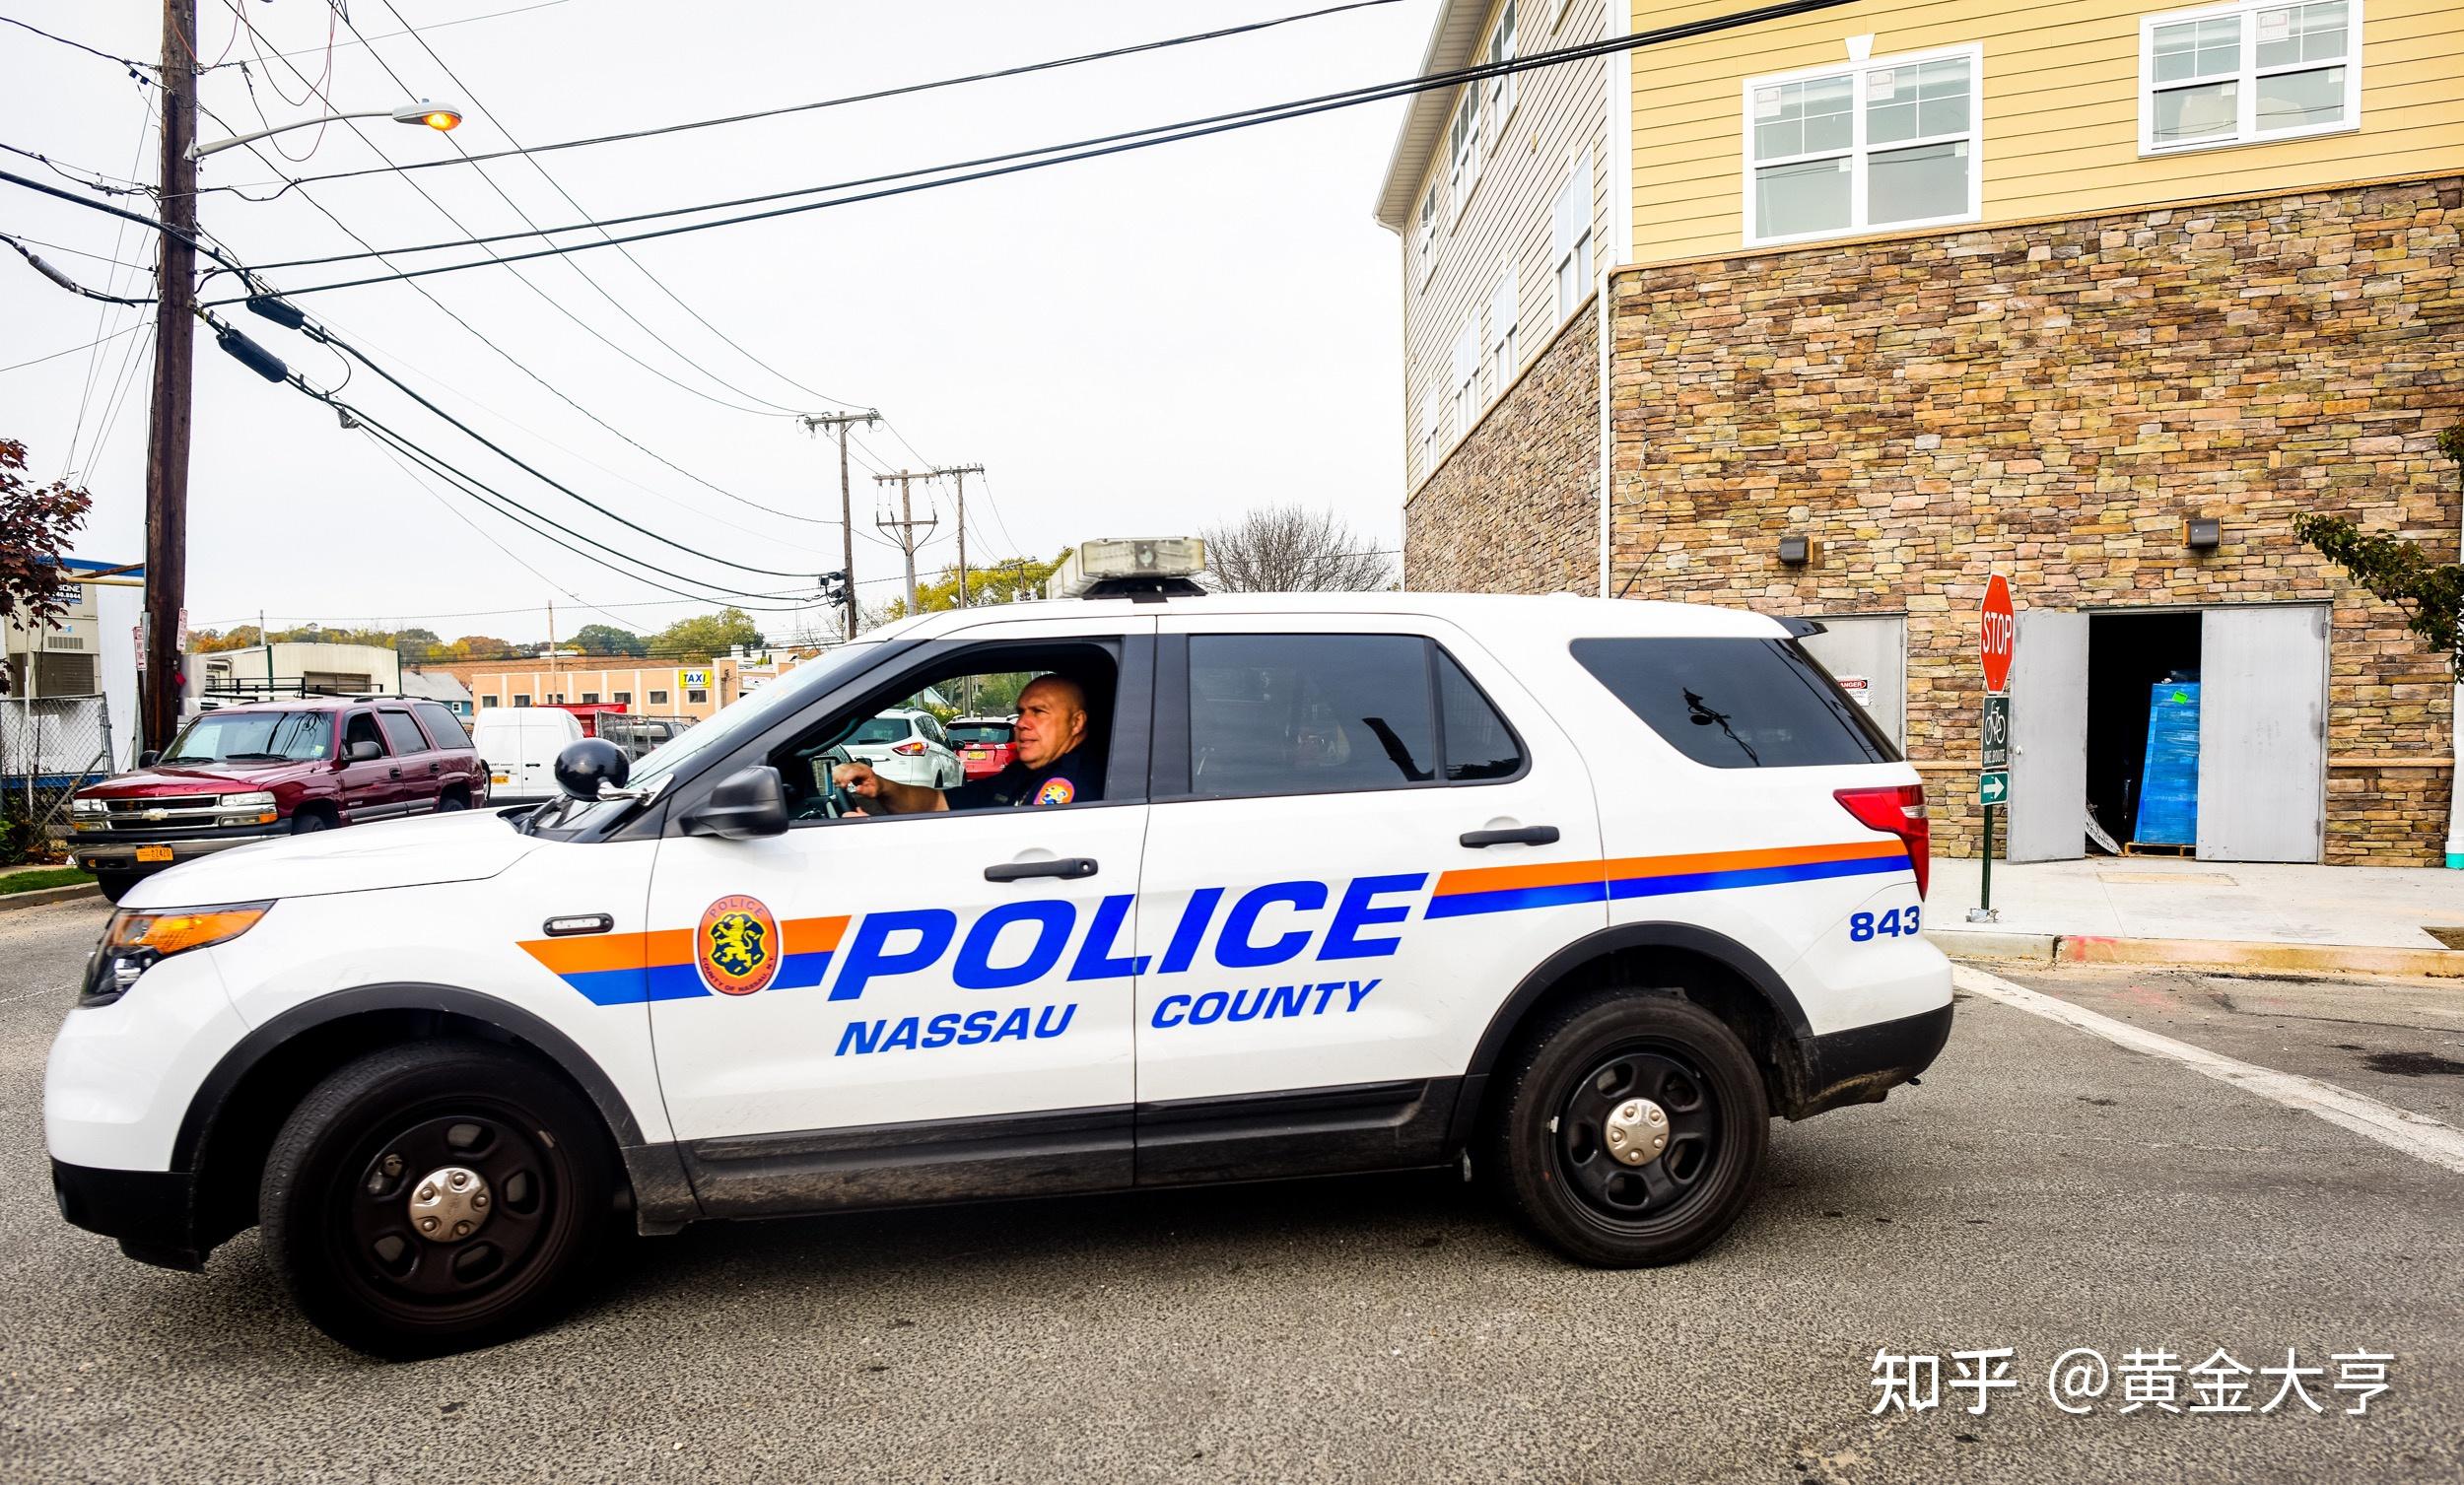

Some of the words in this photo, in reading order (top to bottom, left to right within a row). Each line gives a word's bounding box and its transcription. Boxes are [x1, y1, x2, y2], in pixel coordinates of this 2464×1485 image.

[1982, 611, 2013, 655] STOP
[683, 673, 707, 683] TAXI
[710, 899, 764, 918] POLICE
[1850, 905, 1920, 942] 843
[827, 872, 1429, 1002] POLICE
[702, 957, 723, 986] COUNTY
[835, 1004, 1077, 1056] NASSAU
[1151, 979, 1383, 1029] COUNTY
